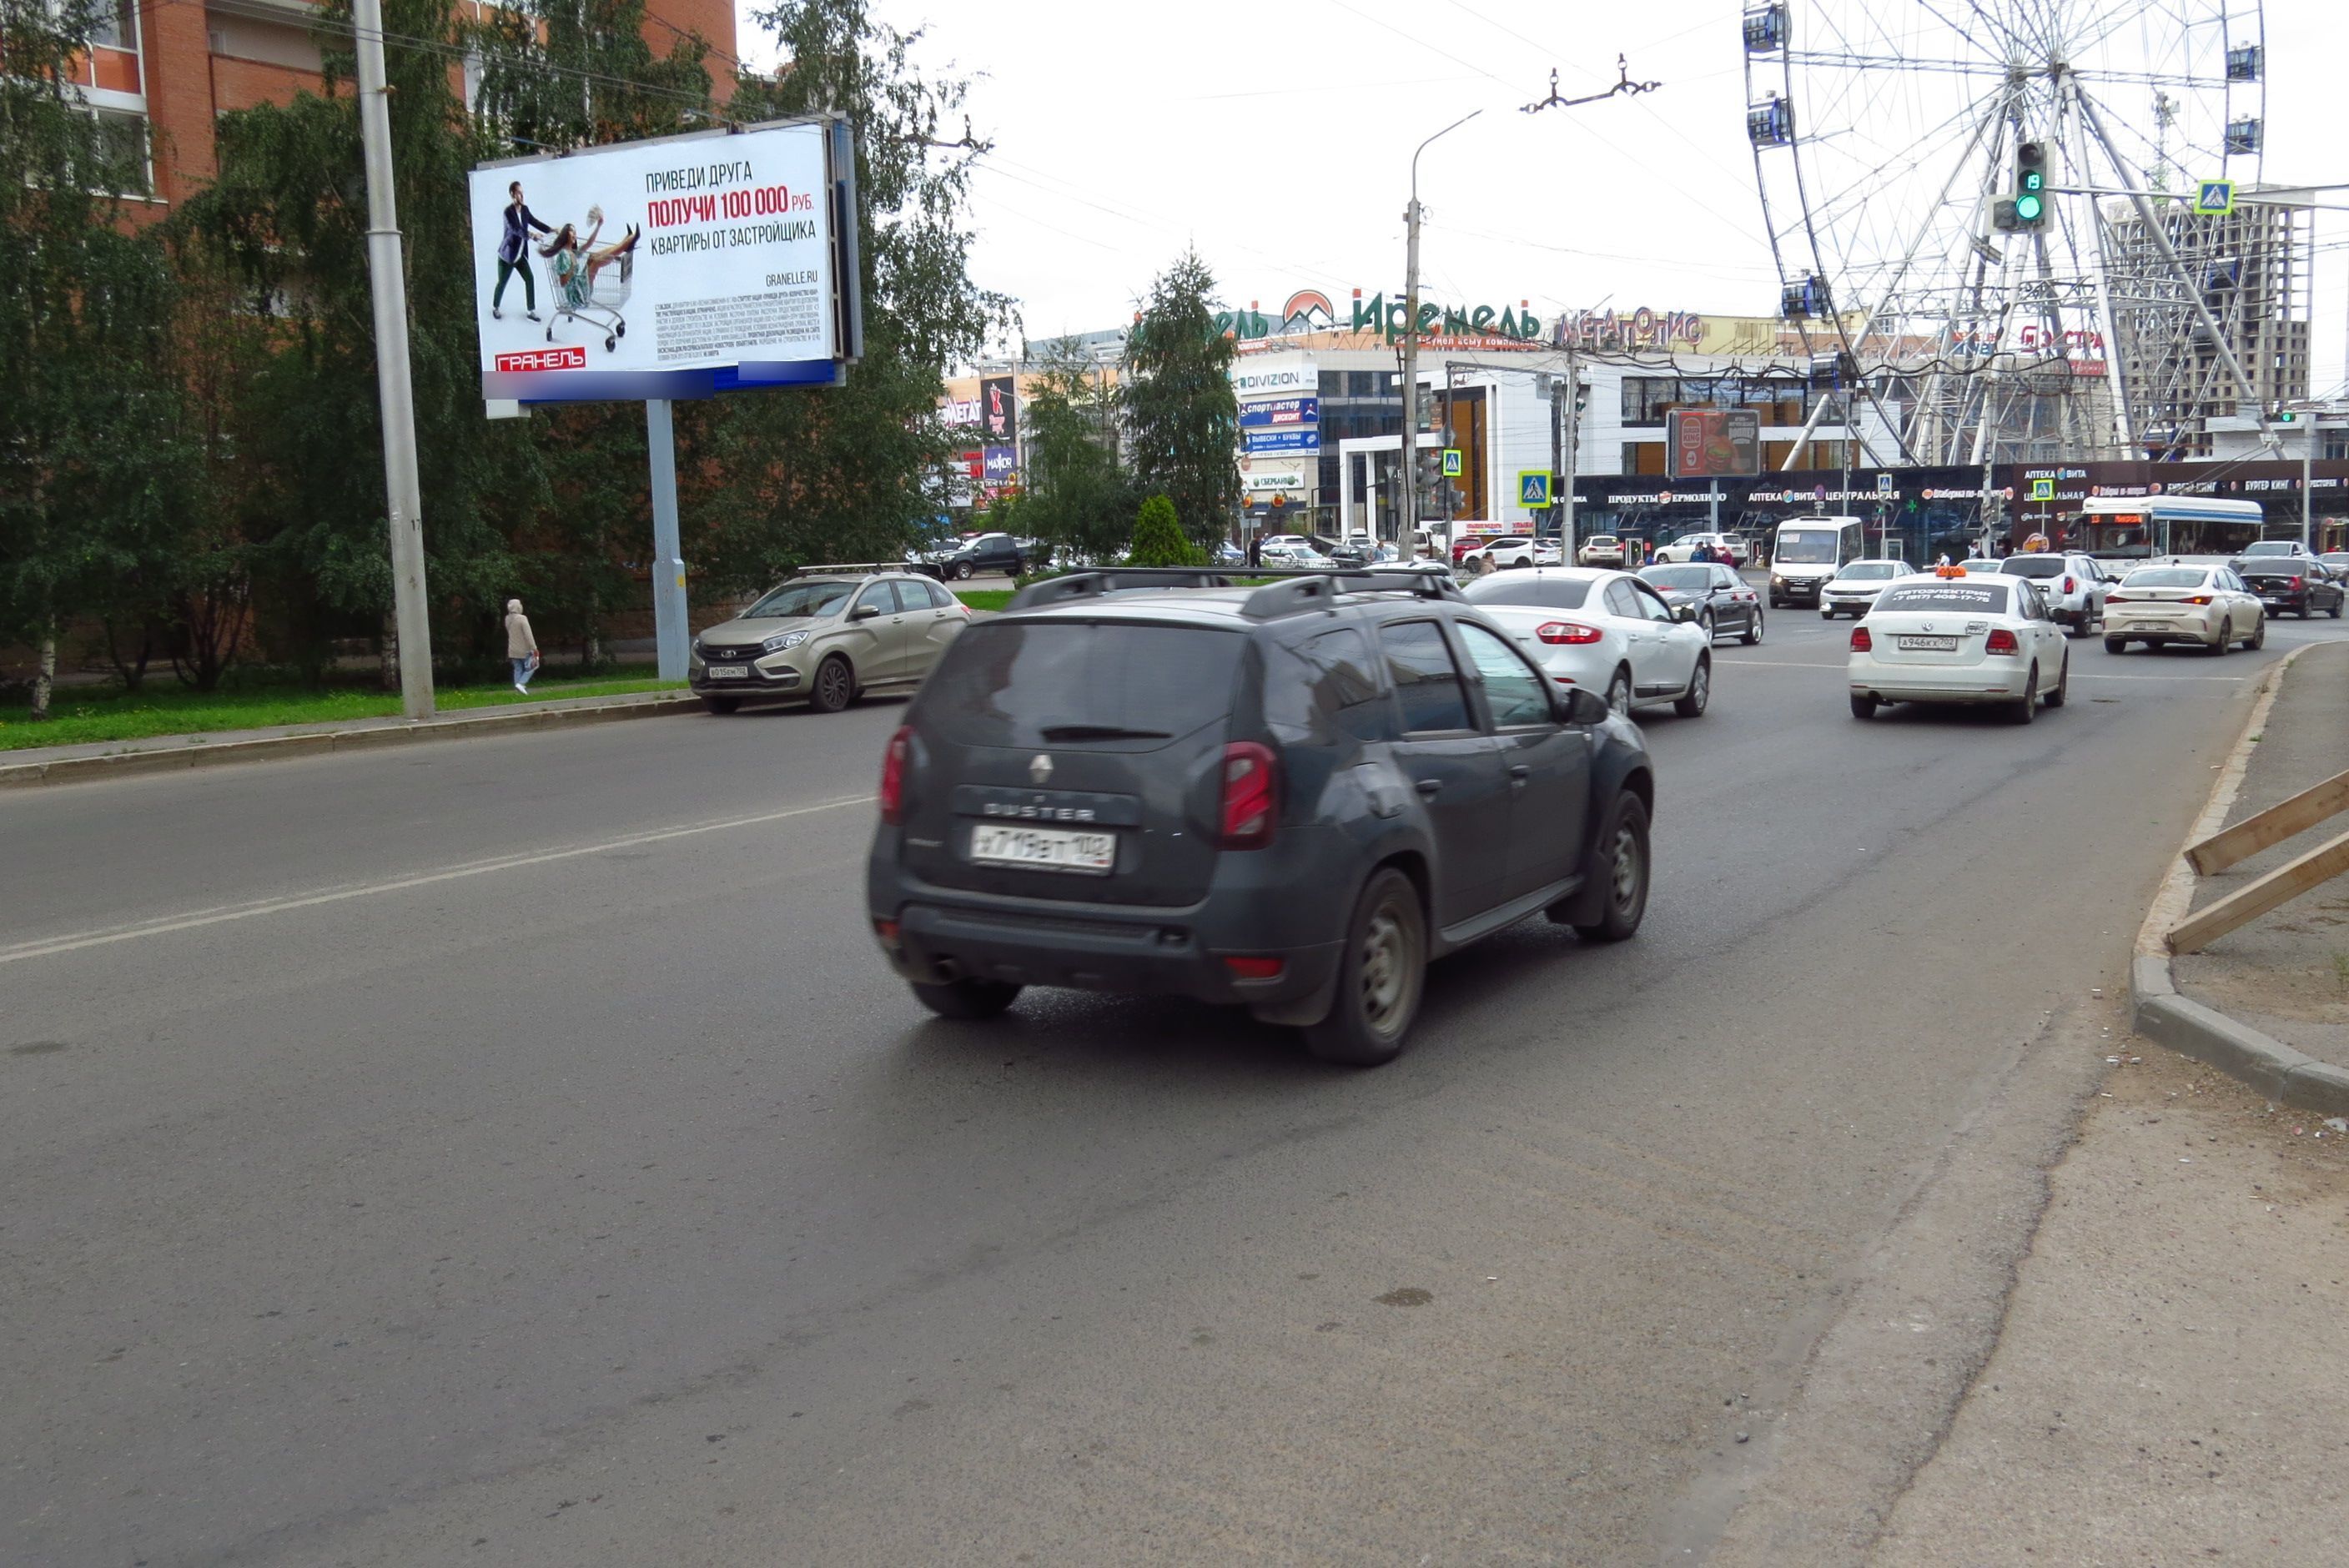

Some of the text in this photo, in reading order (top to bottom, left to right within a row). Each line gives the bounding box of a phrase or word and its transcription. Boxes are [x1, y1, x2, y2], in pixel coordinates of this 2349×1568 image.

[646, 161, 752, 193] ПРИВЕДИ ДРУГА
[2028, 174, 2040, 189] 19
[648, 186, 814, 227] ПОЛУЧИ 100 000 РУБ.
[651, 220, 816, 256] КВАРТИРЫ ОТ ЗАСТРОЙЩИКА
[766, 270, 818, 287] GRANELLE.RU
[1352, 288, 1541, 345] Иремель
[1559, 306, 1704, 348] МЕГАПОЛИС
[497, 351, 584, 370] ГРАНЕЛЬ
[1248, 372, 1299, 388] DIVIZION
[2025, 470, 2085, 480] АПТЕКА ВИТА
[2245, 480, 2289, 490] БУРГЕР КИНГ
[1608, 493, 1727, 504] ПРОДУКТЫ ЕРМОЛИО
[1748, 493, 1782, 501] АПТЕКА
[1794, 492, 1817, 500] ВИТА
[1894, 588, 1992, 597] АВТОЭЛЕКТРИК
[983, 803, 1094, 821] DUSTER
